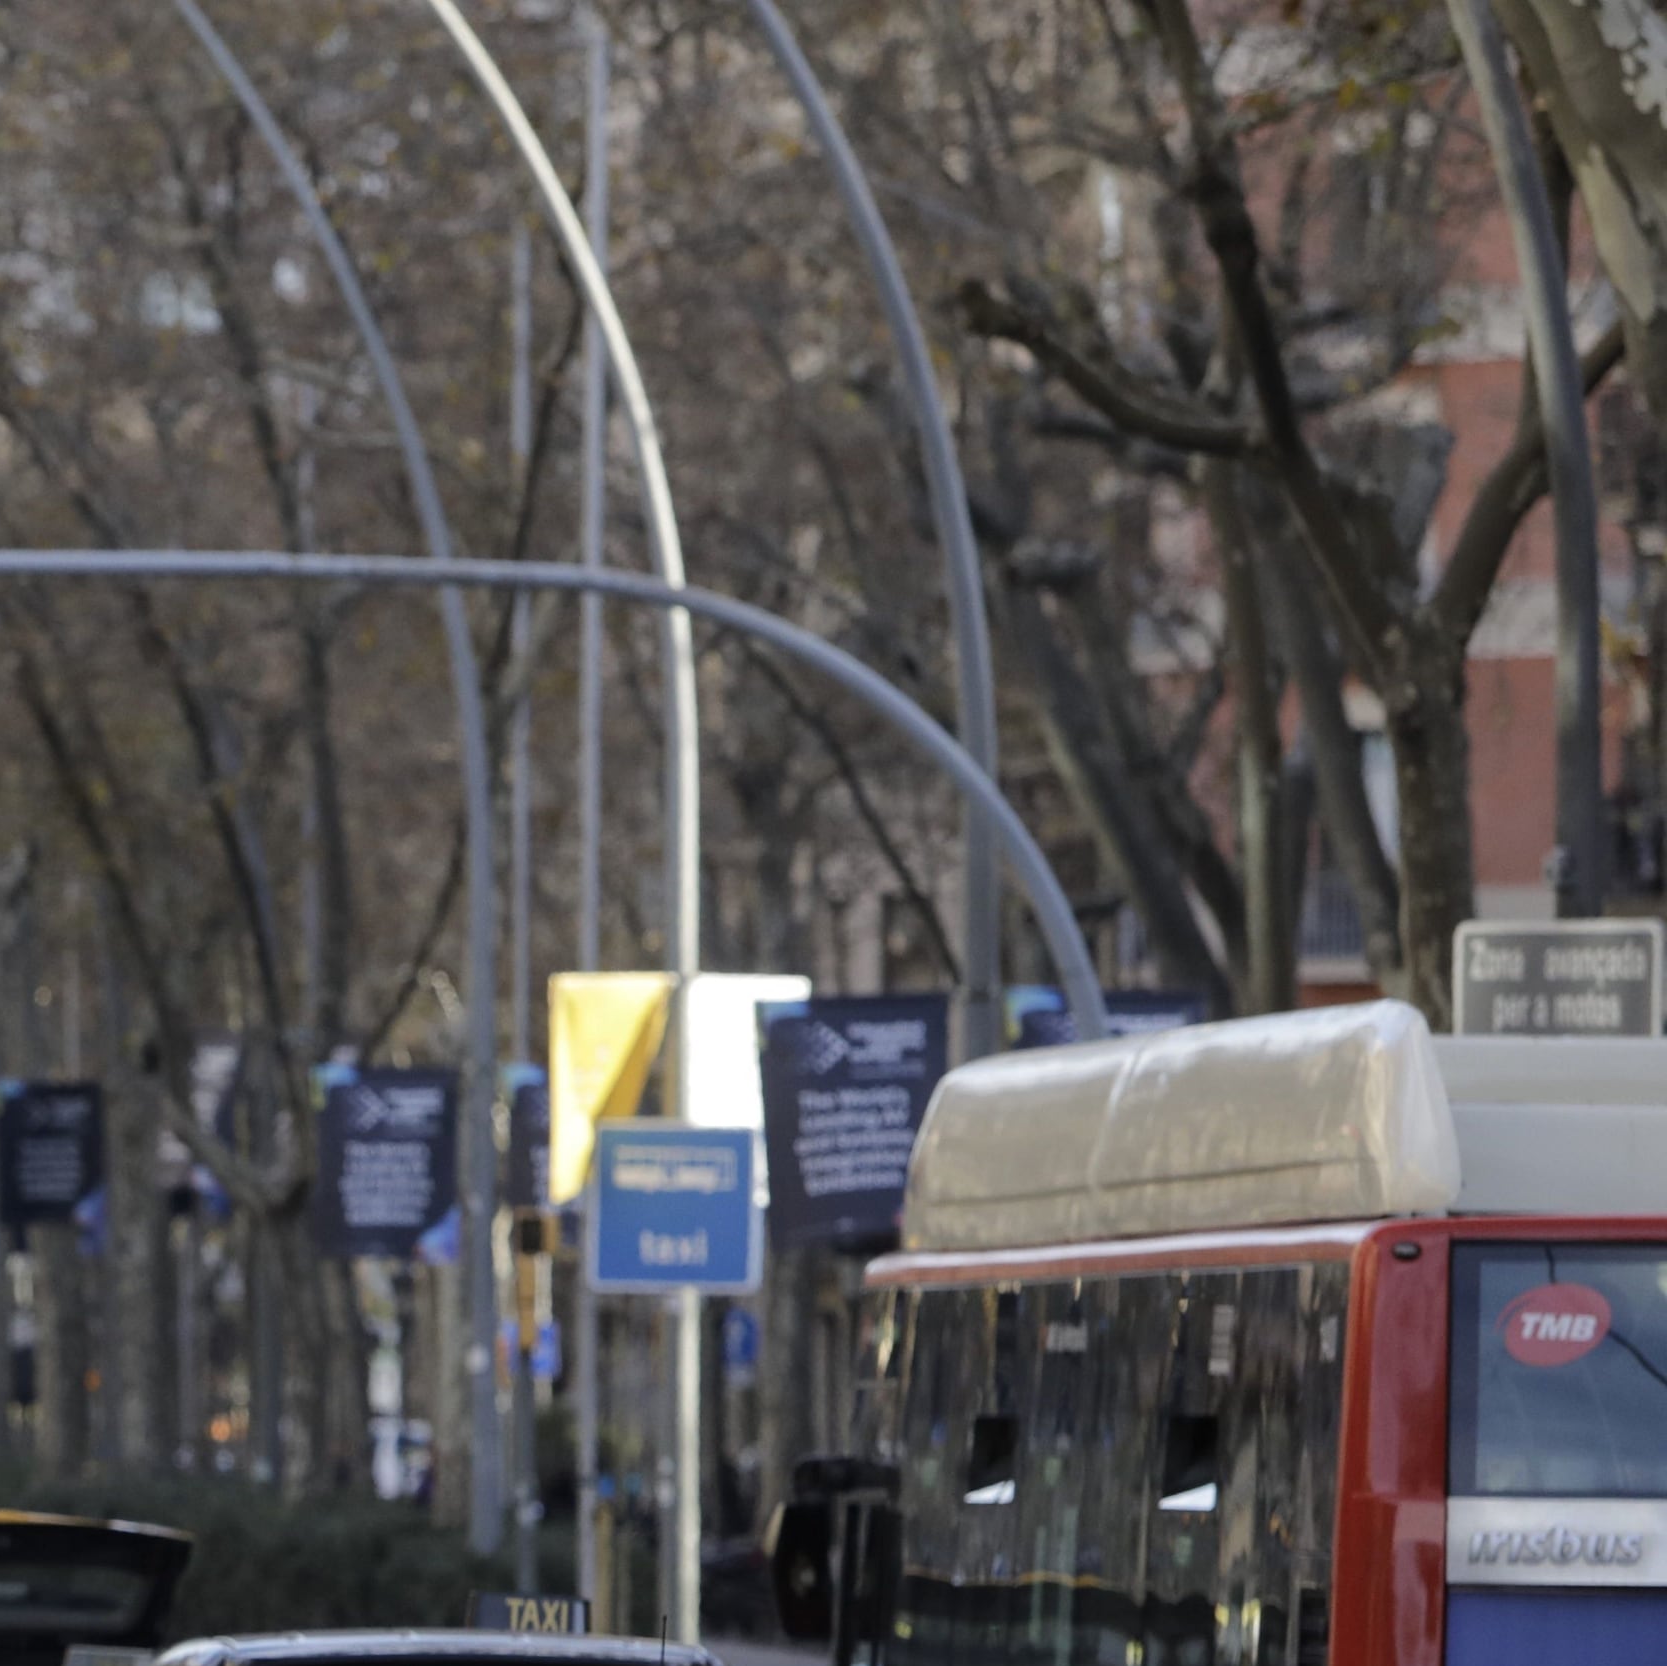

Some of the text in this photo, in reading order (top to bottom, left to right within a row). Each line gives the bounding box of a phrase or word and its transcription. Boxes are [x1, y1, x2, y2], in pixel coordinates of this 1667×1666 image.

[639, 1228, 708, 1267] taxi
[1520, 1312, 1597, 1342] TMB
[506, 1597, 568, 1633] TAXI
